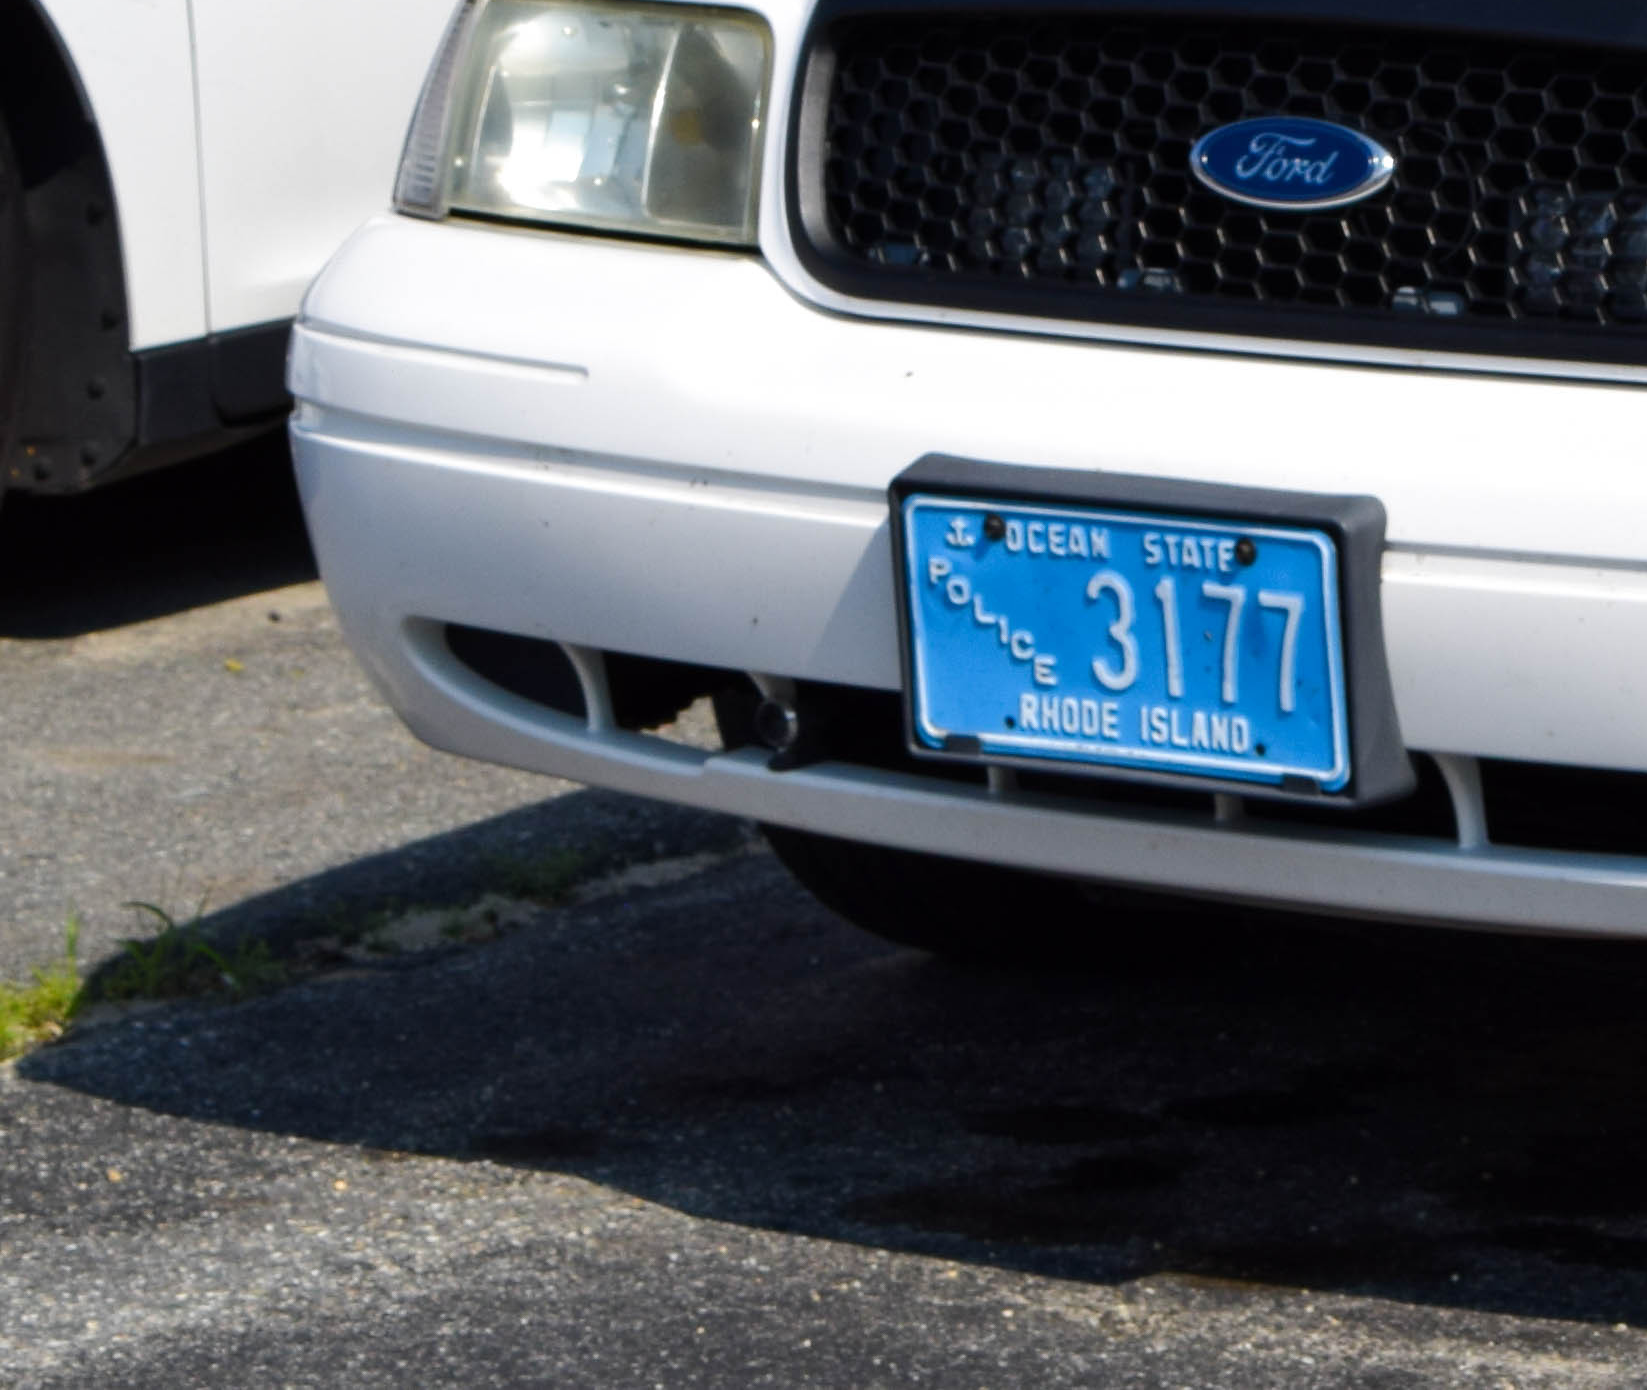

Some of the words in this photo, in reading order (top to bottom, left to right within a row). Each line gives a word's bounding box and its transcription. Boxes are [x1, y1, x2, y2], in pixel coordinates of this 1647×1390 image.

[1236, 132, 1339, 183] Ford
[1005, 520, 1110, 559] OCEAN
[1143, 532, 1236, 573] STATE
[928, 557, 1058, 687] POLICE
[1086, 570, 1305, 712] 3177
[1019, 693, 1121, 739] RHODE
[1140, 705, 1250, 754] ISLAND
